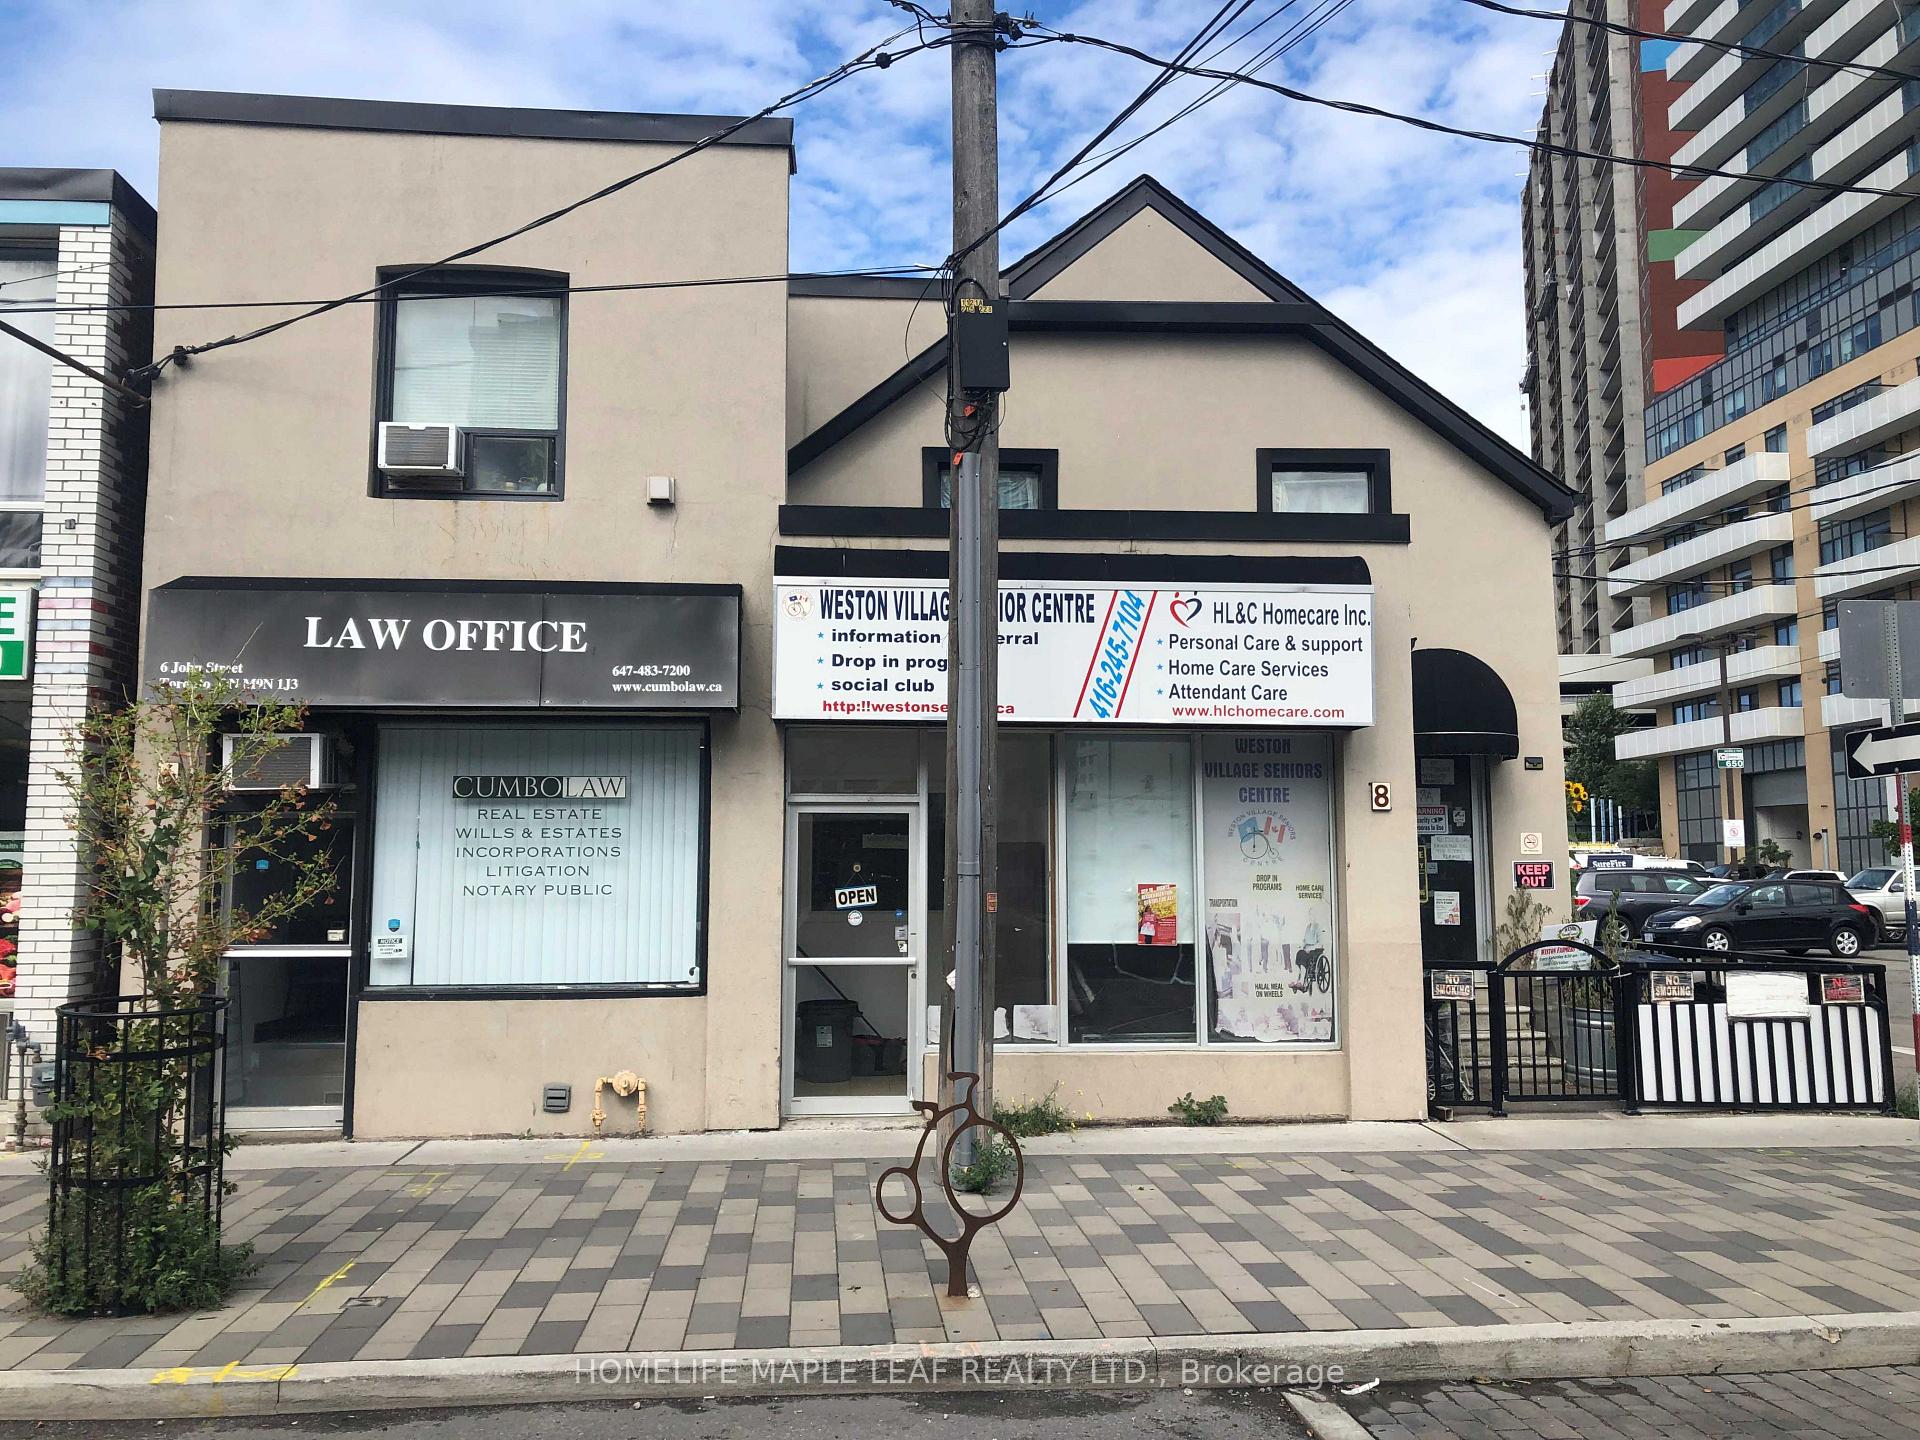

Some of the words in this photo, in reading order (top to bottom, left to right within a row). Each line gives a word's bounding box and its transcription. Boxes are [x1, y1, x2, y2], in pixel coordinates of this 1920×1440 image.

[820, 590, 887, 620] WESTON
[893, 590, 949, 621] VILLAG
[1032, 593, 1095, 623] CENTRE
[1213, 601, 1258, 625] HL&C
[1263, 603, 1339, 626] Homecare
[1344, 603, 1371, 627] Inc.
[305, 616, 411, 649] LAW
[422, 618, 588, 653] OFFICE
[831, 629, 940, 644] information
[1169, 634, 1238, 651] Personal
[1244, 635, 1280, 651] Care
[1285, 636, 1296, 651] &
[1301, 636, 1363, 655] support
[1089, 590, 1146, 719] 416-245-7104
[159, 662, 168, 673] 6
[831, 653, 876, 672] Drop
[883, 654, 900, 668] in
[1169, 660, 1215, 676] Home
[1219, 660, 1256, 677] Care
[1261, 661, 1329, 677] Services
[612, 664, 691, 677] 647-483-7200
[277, 678, 299, 691] 1J3
[612, 681, 723, 694] www.cumbolaw.ca
[831, 678, 888, 692] social
[895, 678, 935, 692] club
[1169, 683, 1246, 700] Attendant
[1251, 685, 1288, 701] Care
[1172, 704, 1345, 719] www.hlchomecare.com
[1235, 738, 1291, 754] WESTON
[1205, 762, 1259, 779] VILLAGE
[1264, 763, 1322, 779] SENIORS
[1239, 787, 1290, 803] CENTRE
[1374, 784, 1389, 807] 8
[477, 809, 528, 820] REAL
[532, 809, 602, 820] ESTATE
[456, 828, 517, 839] WILLS
[521, 828, 534, 839] &
[540, 827, 622, 839] ESTATES
[456, 846, 622, 858] INCORPORATIONS
[1517, 864, 1550, 875] KEEP
[1592, 859, 1627, 868] SureFire
[486, 866, 590, 877] LITIGATION
[1253, 883, 1282, 891] PROGRAMS
[1521, 876, 1547, 887] OUT
[463, 885, 536, 896] NOTARY
[544, 885, 613, 896] PUBLIC
[838, 888, 875, 905] OPEN
[1446, 975, 1460, 984] NO
[1666, 975, 1679, 985] NO
[1435, 984, 1470, 996] SMOKING
[1655, 986, 1691, 996] SMOKING
